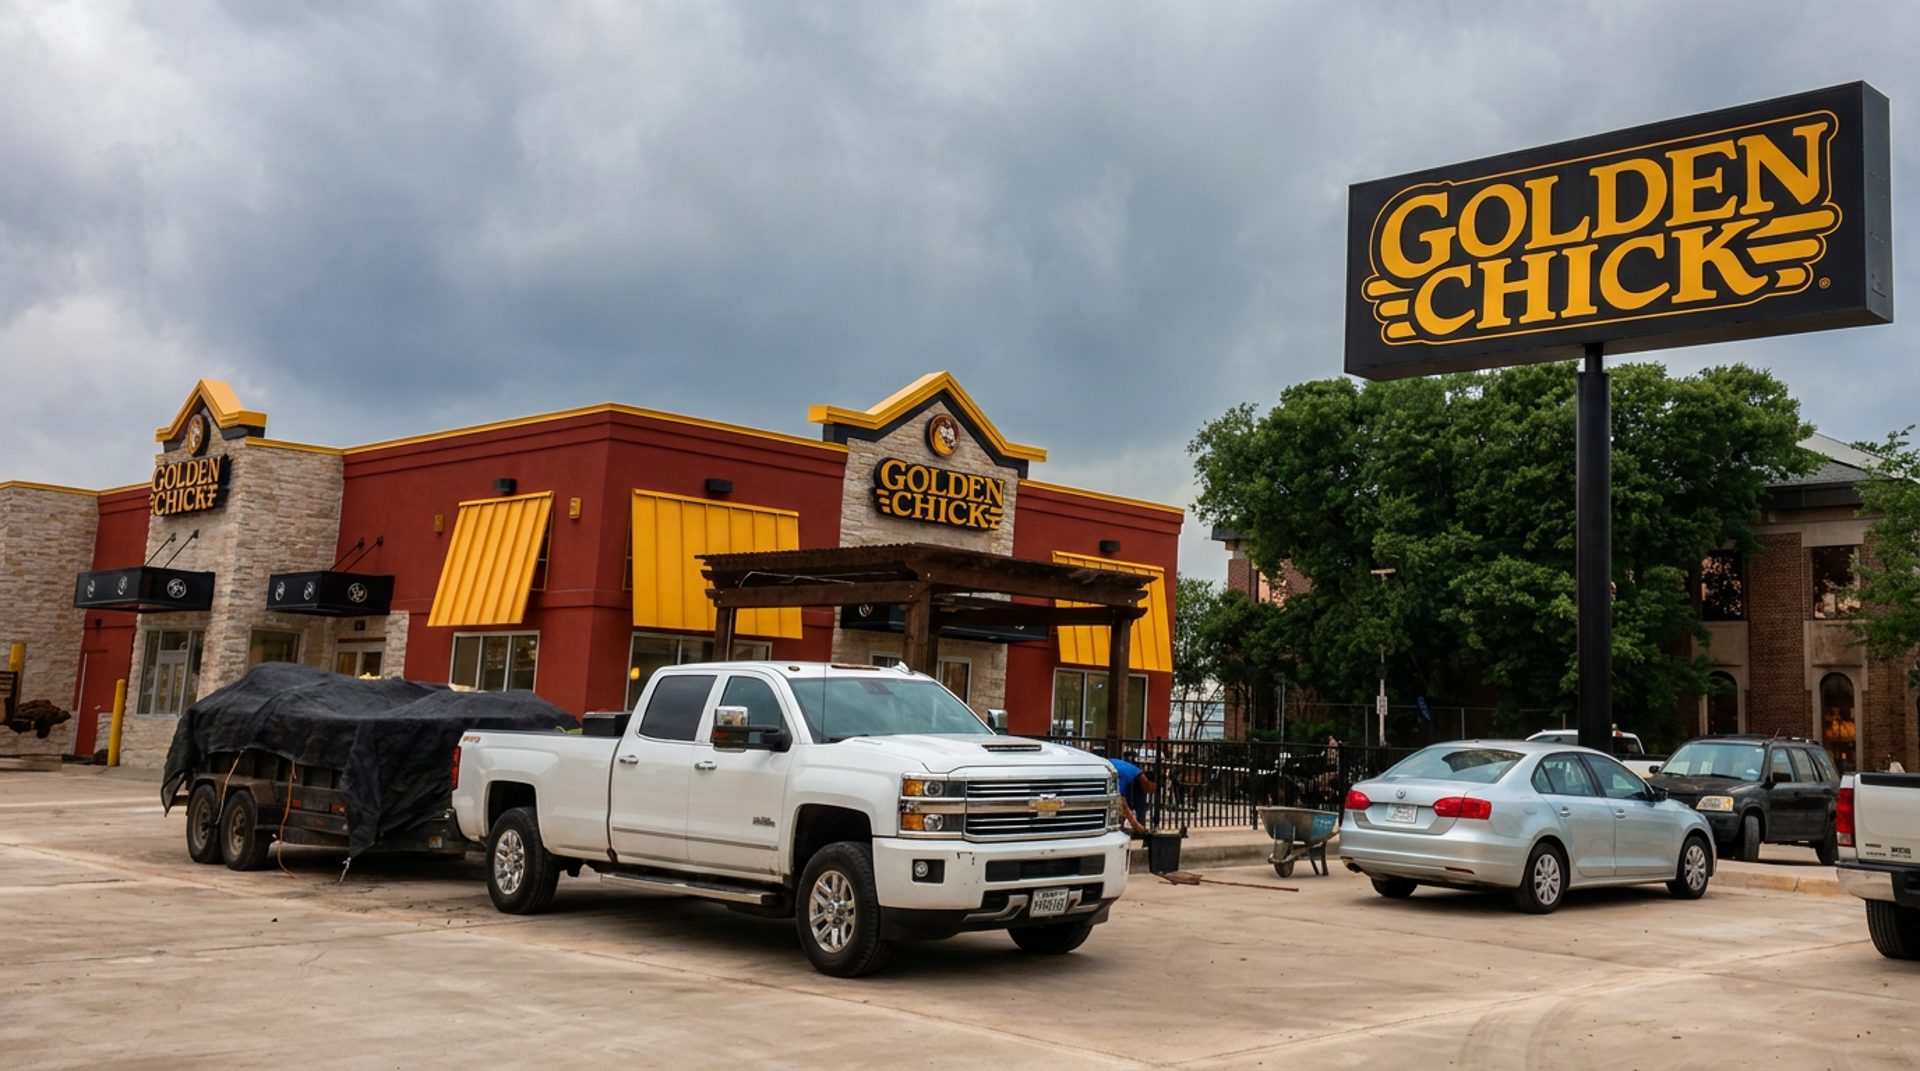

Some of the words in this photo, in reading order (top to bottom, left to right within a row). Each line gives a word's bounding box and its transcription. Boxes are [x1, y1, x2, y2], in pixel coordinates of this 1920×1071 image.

[1381, 121, 1829, 279] GOLDEN
[1414, 218, 1768, 335] CHICK
[152, 456, 221, 492] GOLDEN
[881, 459, 1004, 506] GOLDEN
[155, 486, 206, 516] CHICK
[892, 491, 988, 529] CHICK
